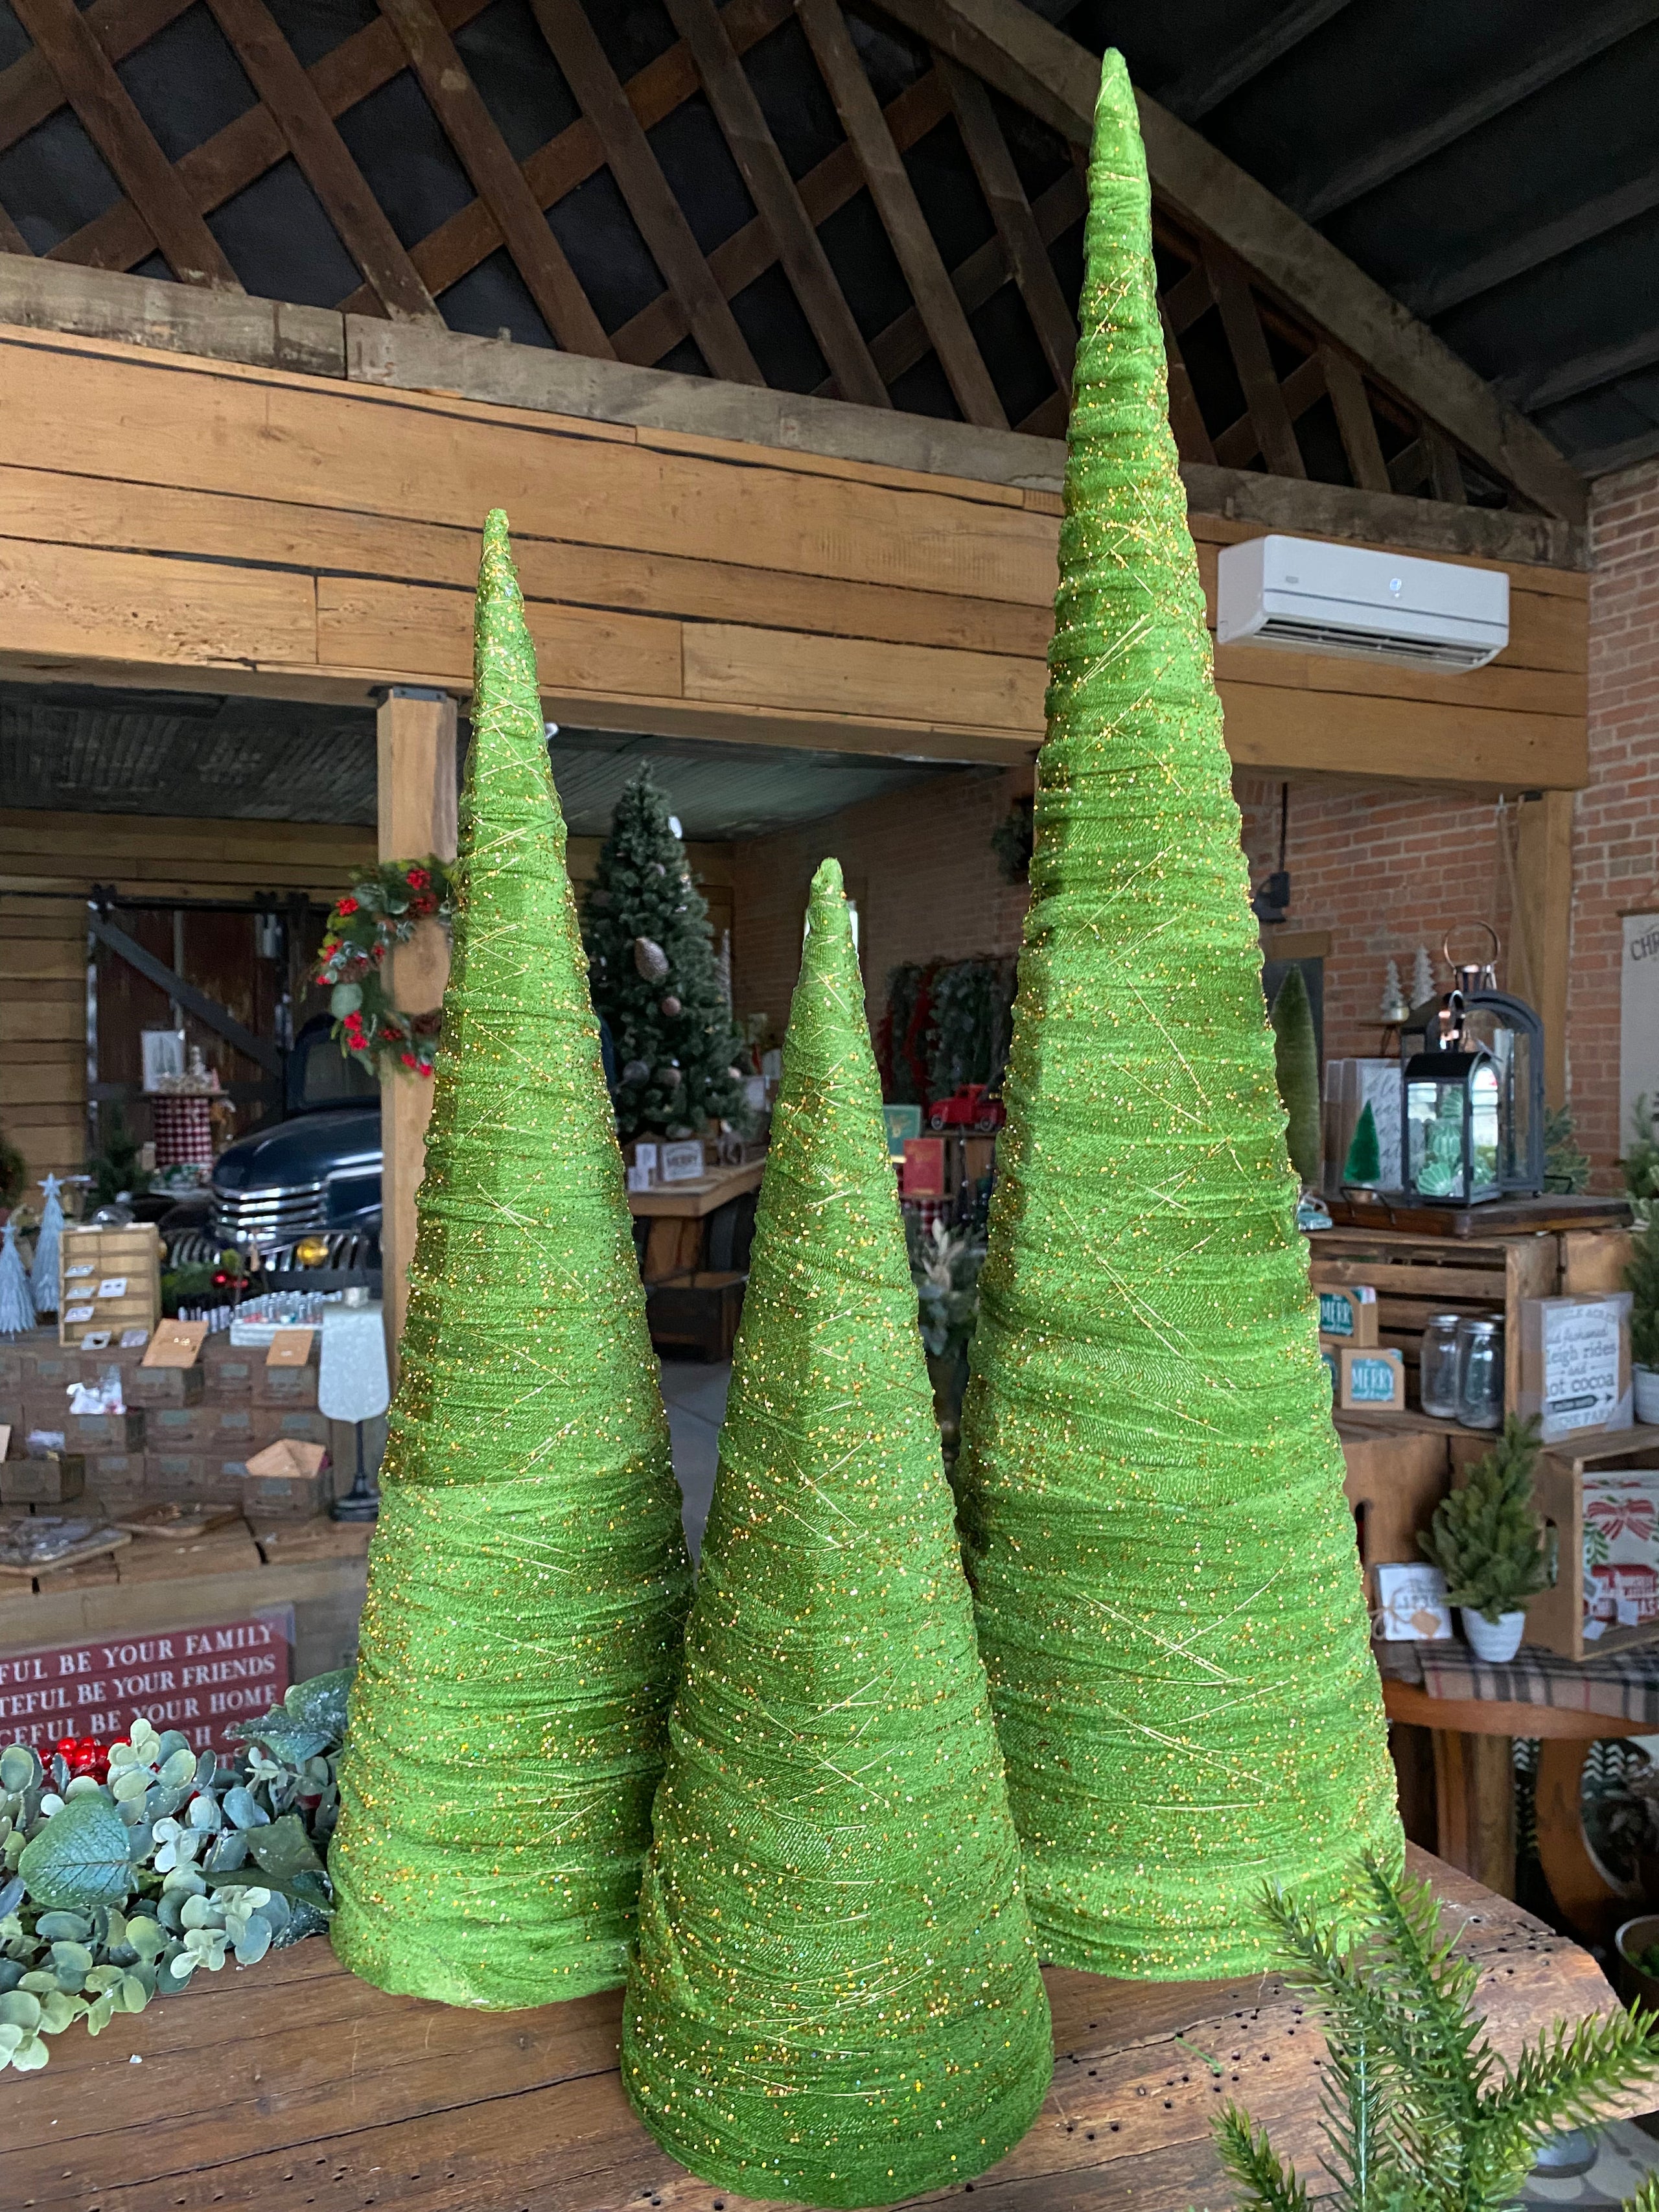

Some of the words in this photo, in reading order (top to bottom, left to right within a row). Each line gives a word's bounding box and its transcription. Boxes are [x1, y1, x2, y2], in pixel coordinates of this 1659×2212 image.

[1572, 1373, 1615, 1393] cocoa
[59, 1651, 92, 1676] BE
[102, 1638, 175, 1669] YOUR
[185, 1622, 274, 1657] FAMILY
[76, 1681, 107, 1706] BE
[112, 1670, 176, 1699] YOUR
[181, 1653, 276, 1688] FRIENDS
[89, 1710, 122, 1735] BE
[210, 1683, 277, 1715] HOME
